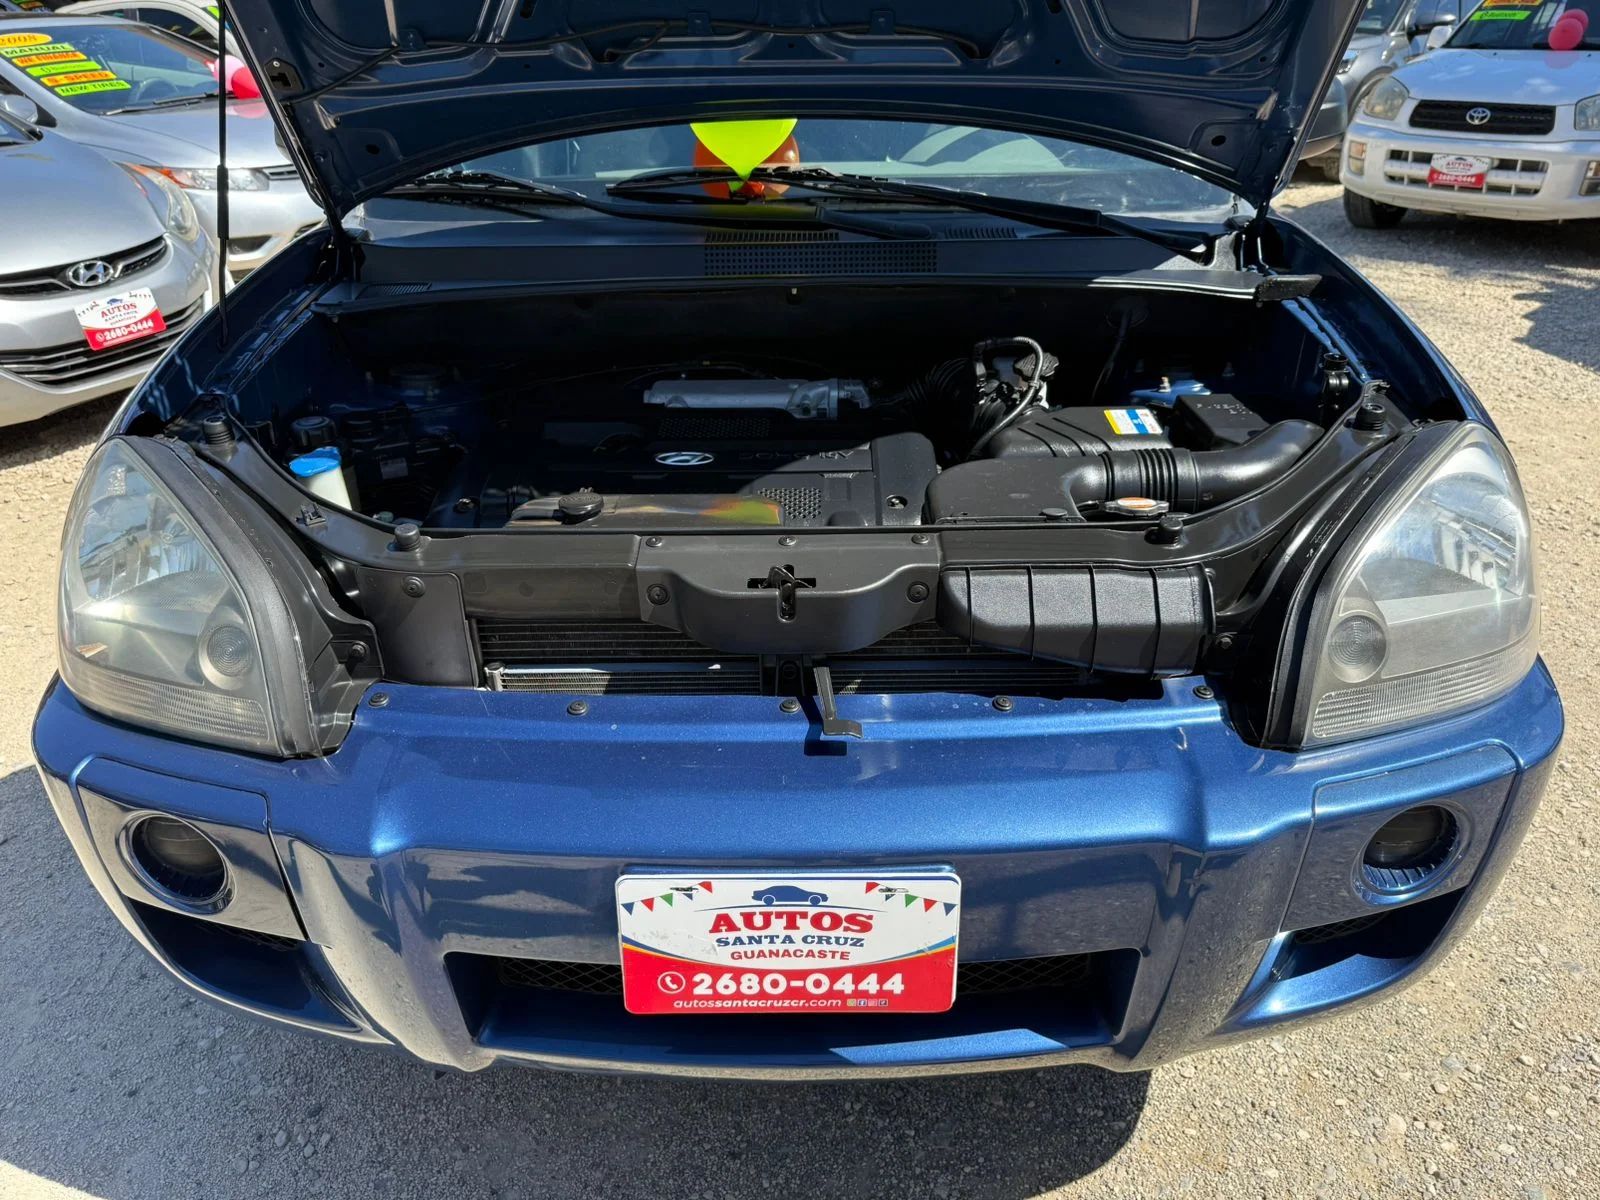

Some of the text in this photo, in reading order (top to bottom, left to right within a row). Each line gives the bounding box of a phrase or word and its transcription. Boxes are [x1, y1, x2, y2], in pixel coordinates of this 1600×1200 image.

[4, 44, 68, 56] MANUAL
[61, 80, 126, 93] NEW TIRES
[101, 302, 137, 319] AUTOS
[104, 319, 154, 341] 2680-0444
[709, 911, 873, 933] AUTOS
[716, 934, 865, 948] SANTA CRUZ
[730, 949, 851, 961] GUANACASTE
[692, 973, 905, 995] 2680-0444
[673, 999, 842, 1009] autossantacruzcr.com
